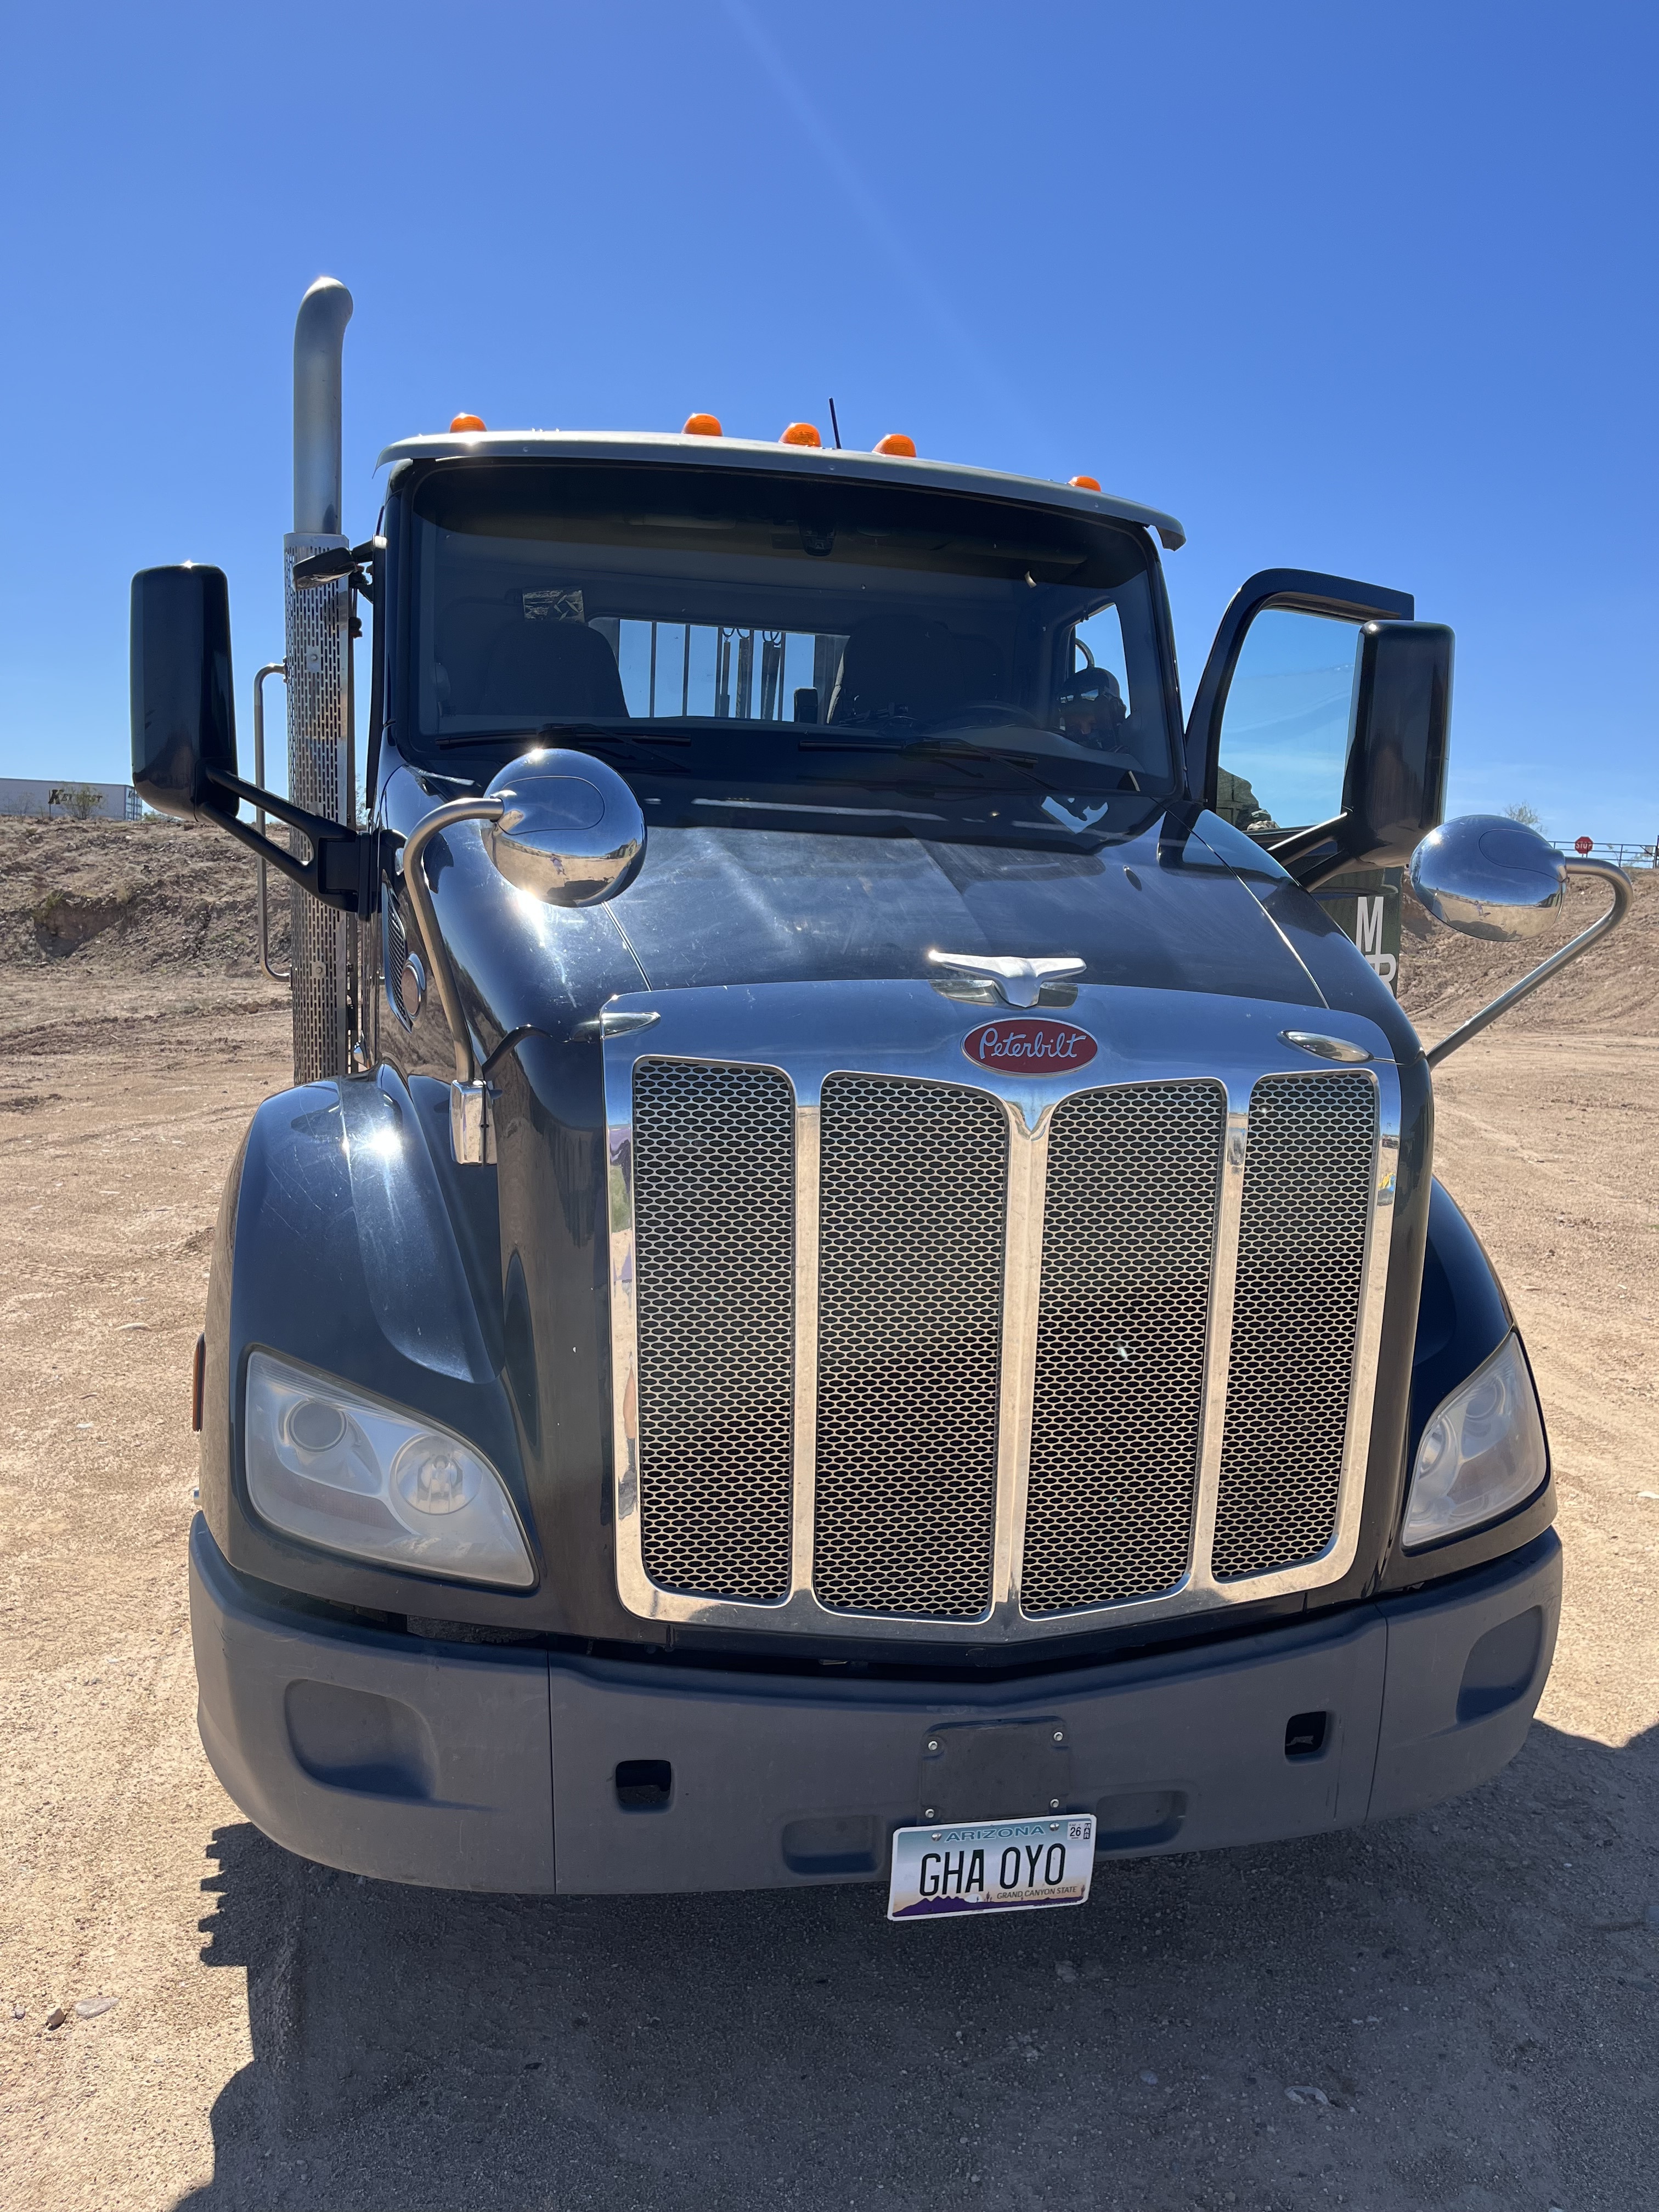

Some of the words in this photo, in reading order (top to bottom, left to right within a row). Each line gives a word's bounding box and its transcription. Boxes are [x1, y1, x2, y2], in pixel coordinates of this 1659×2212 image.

[1575, 841, 1592, 849] STOP
[979, 1028, 1086, 1059] Peterbilt
[944, 1825, 1045, 1843] ARIZONA
[1070, 1826, 1081, 1836] 26
[920, 1849, 985, 1896] GHA
[997, 1891, 1024, 1899] GRAND
[1025, 1888, 1056, 1898] CANYON
[1056, 1886, 1077, 1894] STATE
